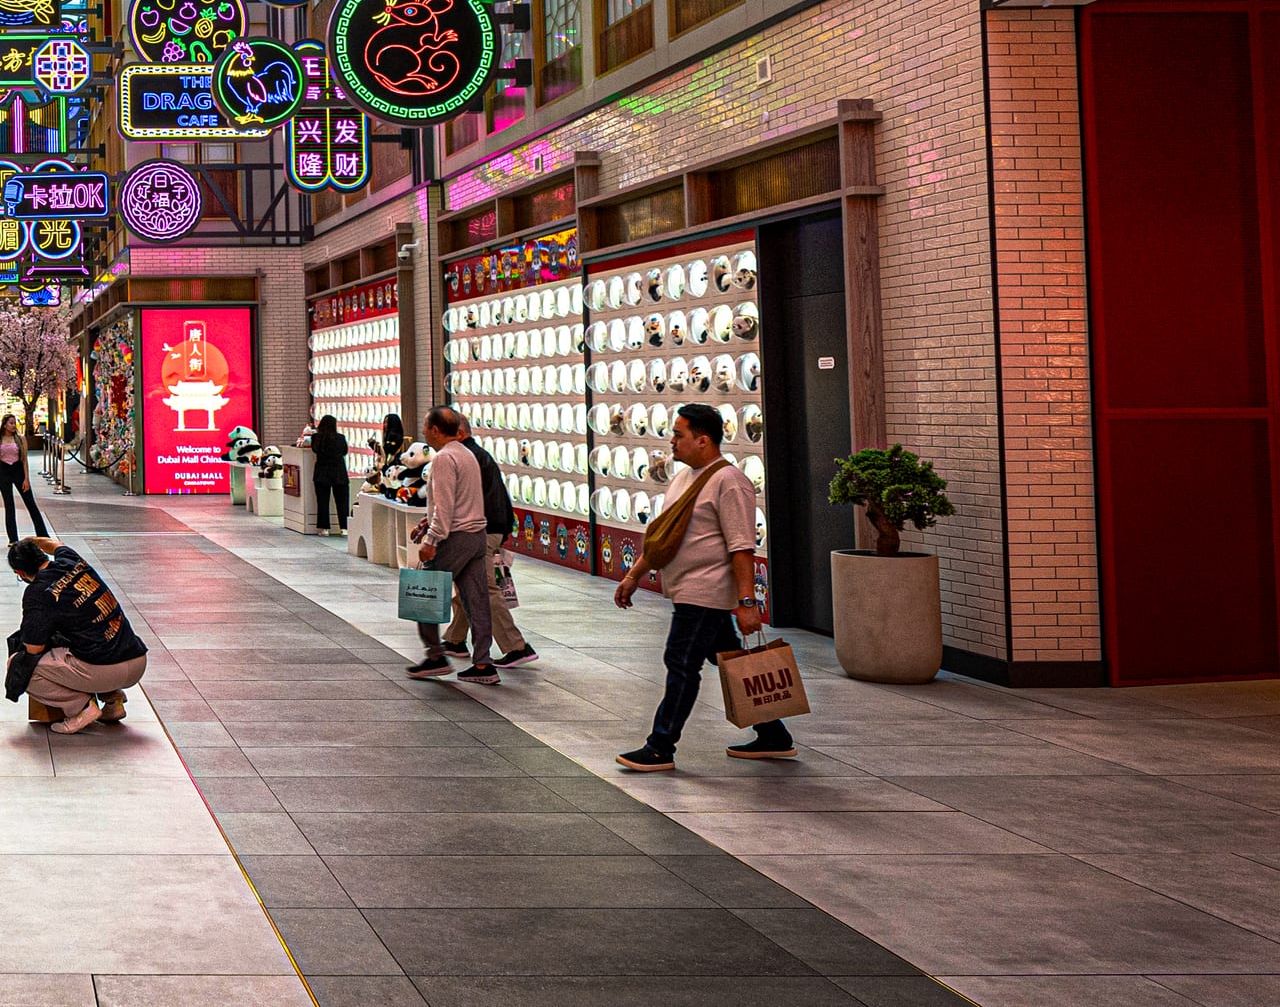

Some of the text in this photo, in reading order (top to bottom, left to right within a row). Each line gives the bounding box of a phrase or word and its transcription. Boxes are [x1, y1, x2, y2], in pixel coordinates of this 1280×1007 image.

[179, 75, 212, 89] THE
[143, 92, 216, 110] DRAG
[177, 114, 219, 126] CAFE
[297, 120, 323, 177] 兴隆
[334, 119, 360, 177] 发财
[23, 183, 105, 210] 卡拉OK
[189, 328, 202, 372] 唐人街
[157, 455, 180, 464] Dubai
[181, 455, 199, 464] Mall
[176, 445, 212, 453] Welcome
[73, 572, 101, 598] SICK
[742, 667, 794, 698] MUJI
